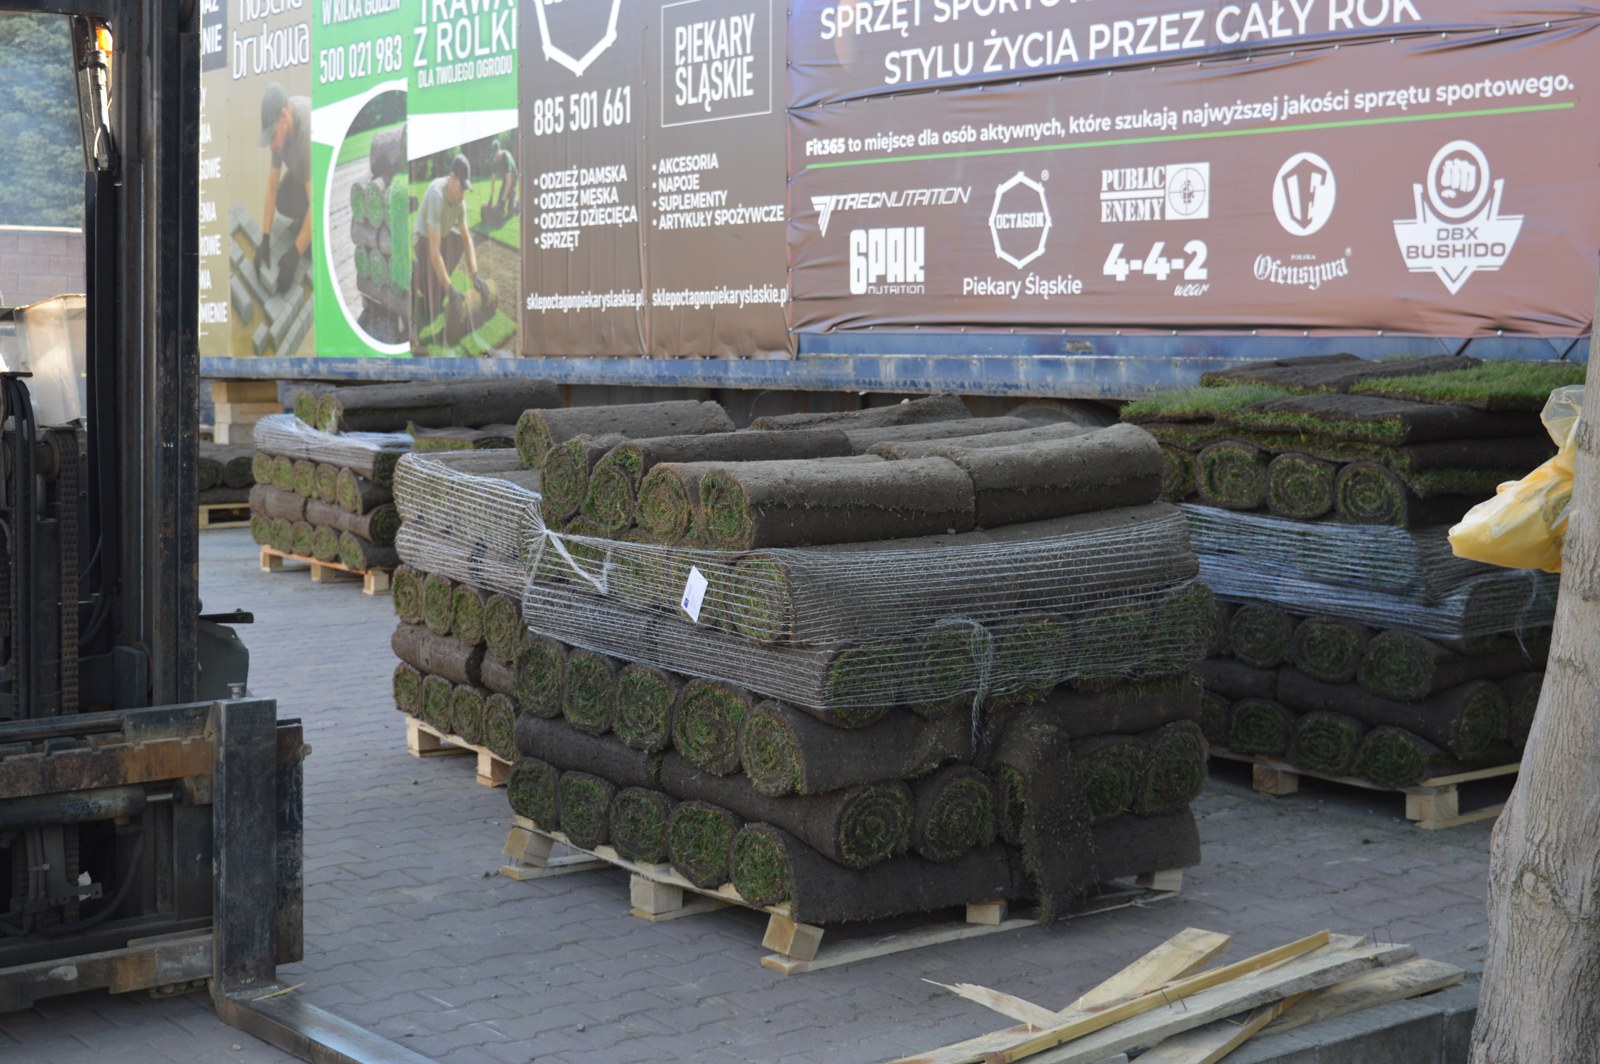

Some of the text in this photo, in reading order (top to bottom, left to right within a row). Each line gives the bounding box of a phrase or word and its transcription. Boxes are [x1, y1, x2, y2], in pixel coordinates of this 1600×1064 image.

[820, 0, 920, 40] SPRZĘT
[1216, 0, 1422, 43] CAŁY ROK
[233, 22, 310, 80] brukowa
[413, 8, 517, 67] Z ROLKI
[675, 13, 755, 66] PIEKARY
[884, 41, 973, 85] STYLU
[983, 28, 1079, 73] ŻYCIA
[1089, 10, 1205, 60] PRZEZ
[320, 34, 402, 84] 500 021 983
[418, 54, 512, 88] DLA TWOJEGO OGRODU
[675, 56, 754, 112] ŚLĄSKIE
[534, 86, 631, 136] 885 501 661
[806, 73, 1574, 157] Fit365 to miejsce dla osób aktywnych, które szukają najwyższej jakości sprzętu sportowego.
[540, 165, 627, 190] ODZIEŻ DAMSKA
[658, 153, 719, 175] AKCESORIA
[658, 175, 700, 193] NAPOJE
[1101, 166, 1165, 192] PUBLIC
[540, 186, 619, 210] ODZIEŻ MĘSKA
[658, 190, 728, 212] SUPLEMENTY
[1101, 198, 1164, 222] ENEMY
[540, 205, 638, 230] ODZIEŻ DZIECIĘCA
[658, 203, 784, 230] ARTYKUŁY SPOŻYWCZE
[996, 211, 1044, 229] OCTAGON
[540, 230, 580, 251] SPRZĘT
[1436, 227, 1478, 241] DBX
[1103, 239, 1208, 281] 4-4-2
[1406, 242, 1506, 259] BUSHIDO
[1253, 253, 1349, 291] Ofensywa
[868, 284, 925, 295] NUTRITION
[963, 272, 1082, 300] Piekary Śląskie
[1173, 283, 1210, 297] wear
